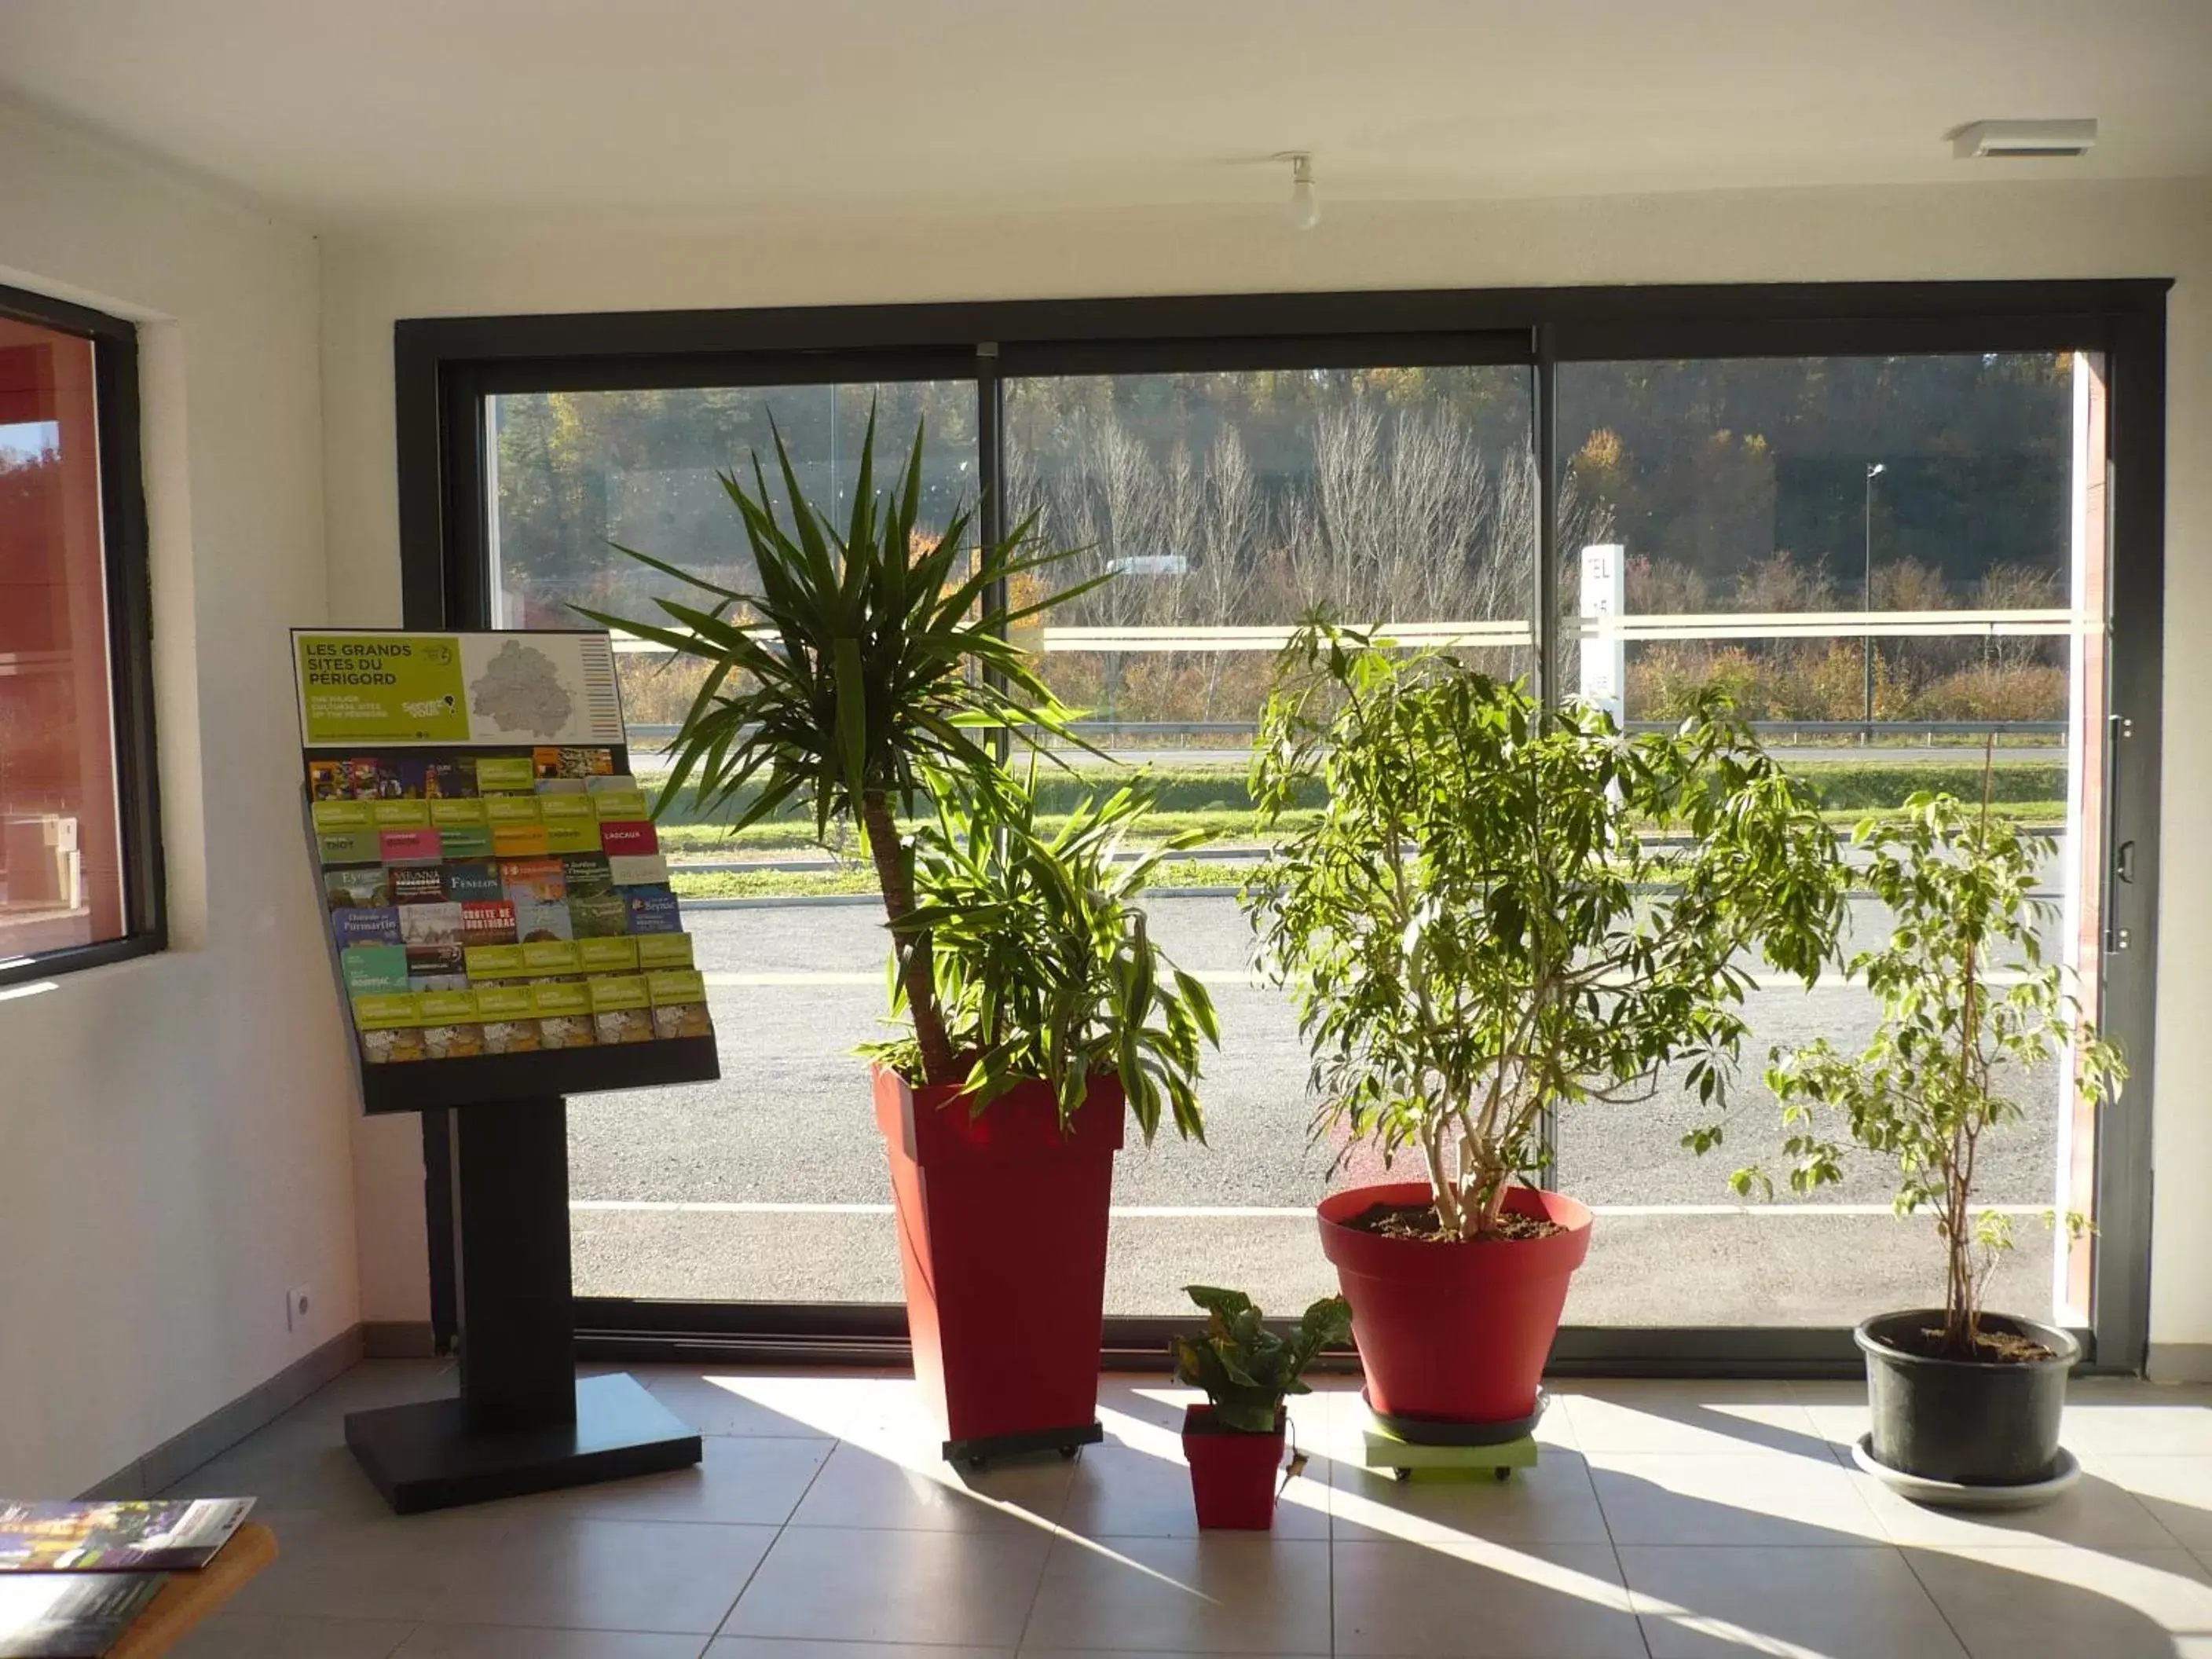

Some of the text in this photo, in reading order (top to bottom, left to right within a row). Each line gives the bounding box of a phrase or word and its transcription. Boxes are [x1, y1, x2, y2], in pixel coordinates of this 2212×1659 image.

[306, 643, 337, 656] LES
[342, 644, 412, 657] GRANDS
[308, 658, 383, 671] SITES DU
[309, 669, 397, 685] PÉRIGORD
[605, 831, 641, 840] LASCAUX
